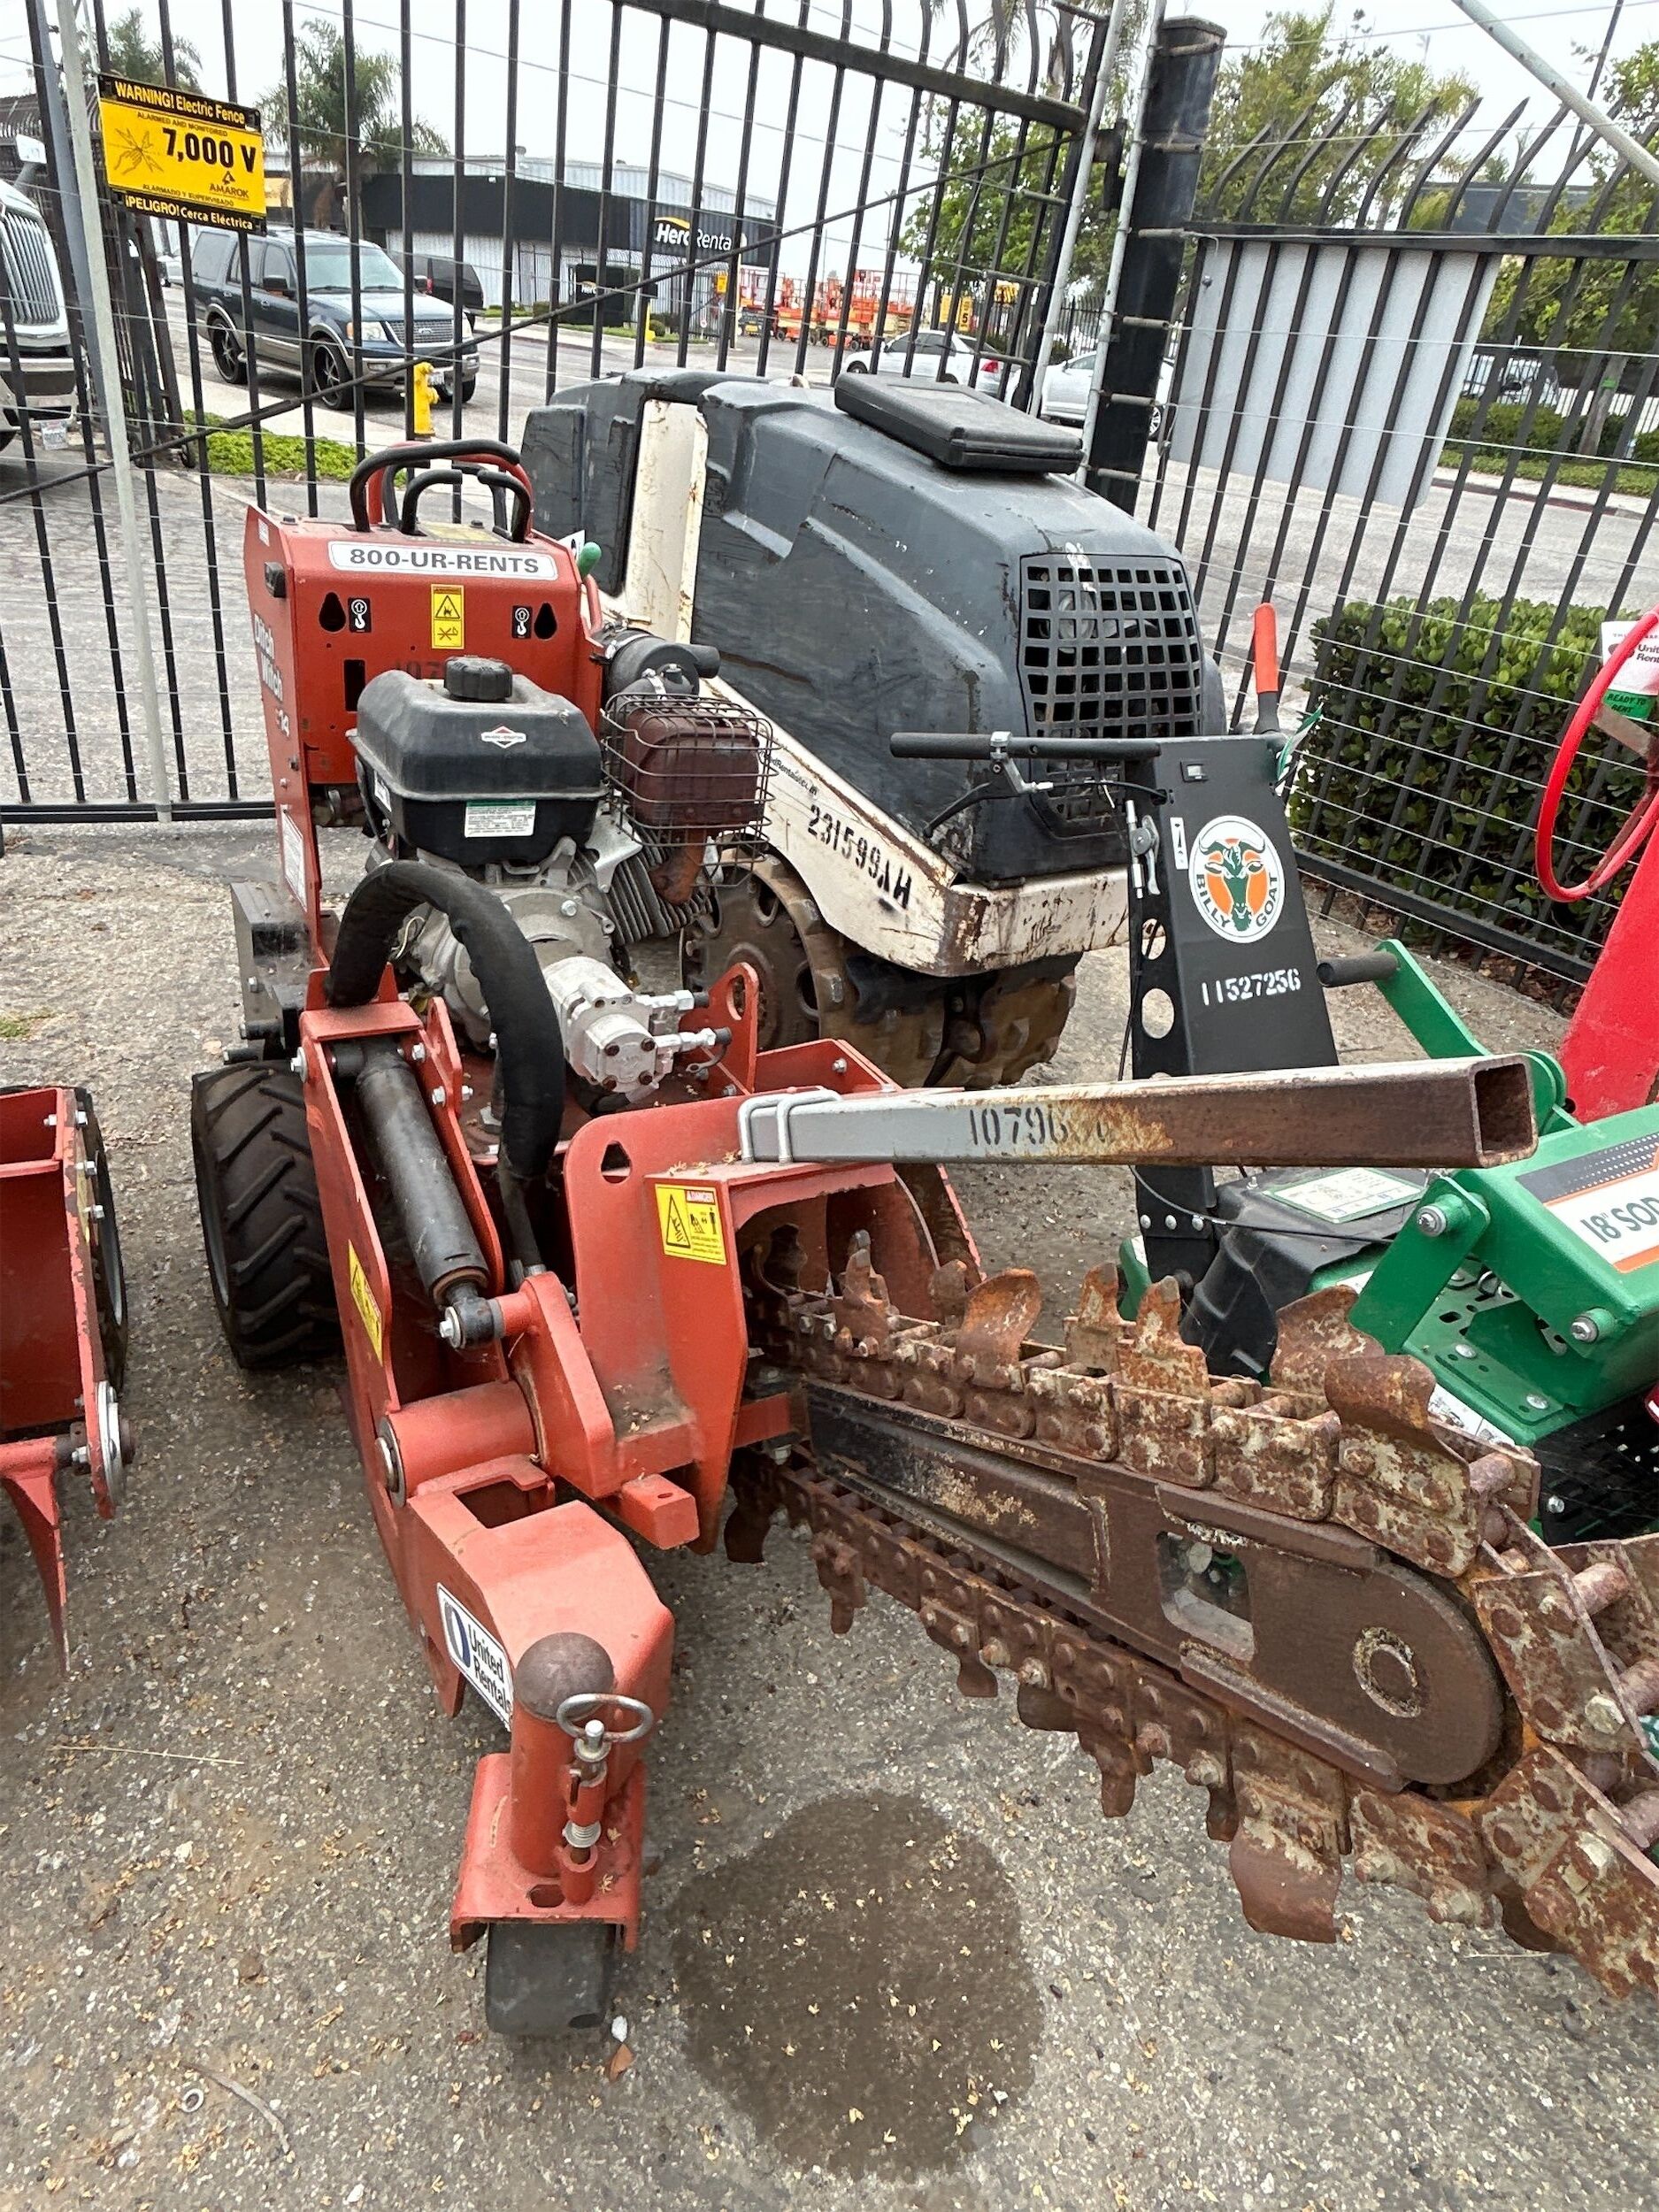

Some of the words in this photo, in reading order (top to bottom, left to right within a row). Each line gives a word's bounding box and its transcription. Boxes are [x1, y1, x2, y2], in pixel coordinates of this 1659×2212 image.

[115, 81, 174, 110] WARNING!
[176, 95, 213, 118] Electric
[215, 104, 245, 125] Fence
[137, 111, 172, 126] ALARMED
[172, 118, 187, 128] AND
[188, 121, 228, 137] MONITORED
[162, 127, 234, 168] 7,000
[241, 144, 257, 173] V
[142, 183, 181, 198] ALARMADO
[209, 182, 250, 198] AMAROK
[125, 195, 180, 217] ¡PELIGRO!
[180, 207, 209, 222] Cerca
[211, 211, 253, 230] Eléctrica
[962, 312, 969, 323] 5
[349, 547, 539, 574] 800-UR-RENTS
[1196, 873, 1231, 928] BILLY
[1255, 872, 1279, 928] GOAT
[1202, 968, 1302, 1006] 11527256
[467, 1623, 505, 1684] United
[472, 1654, 512, 1715] Rentals
